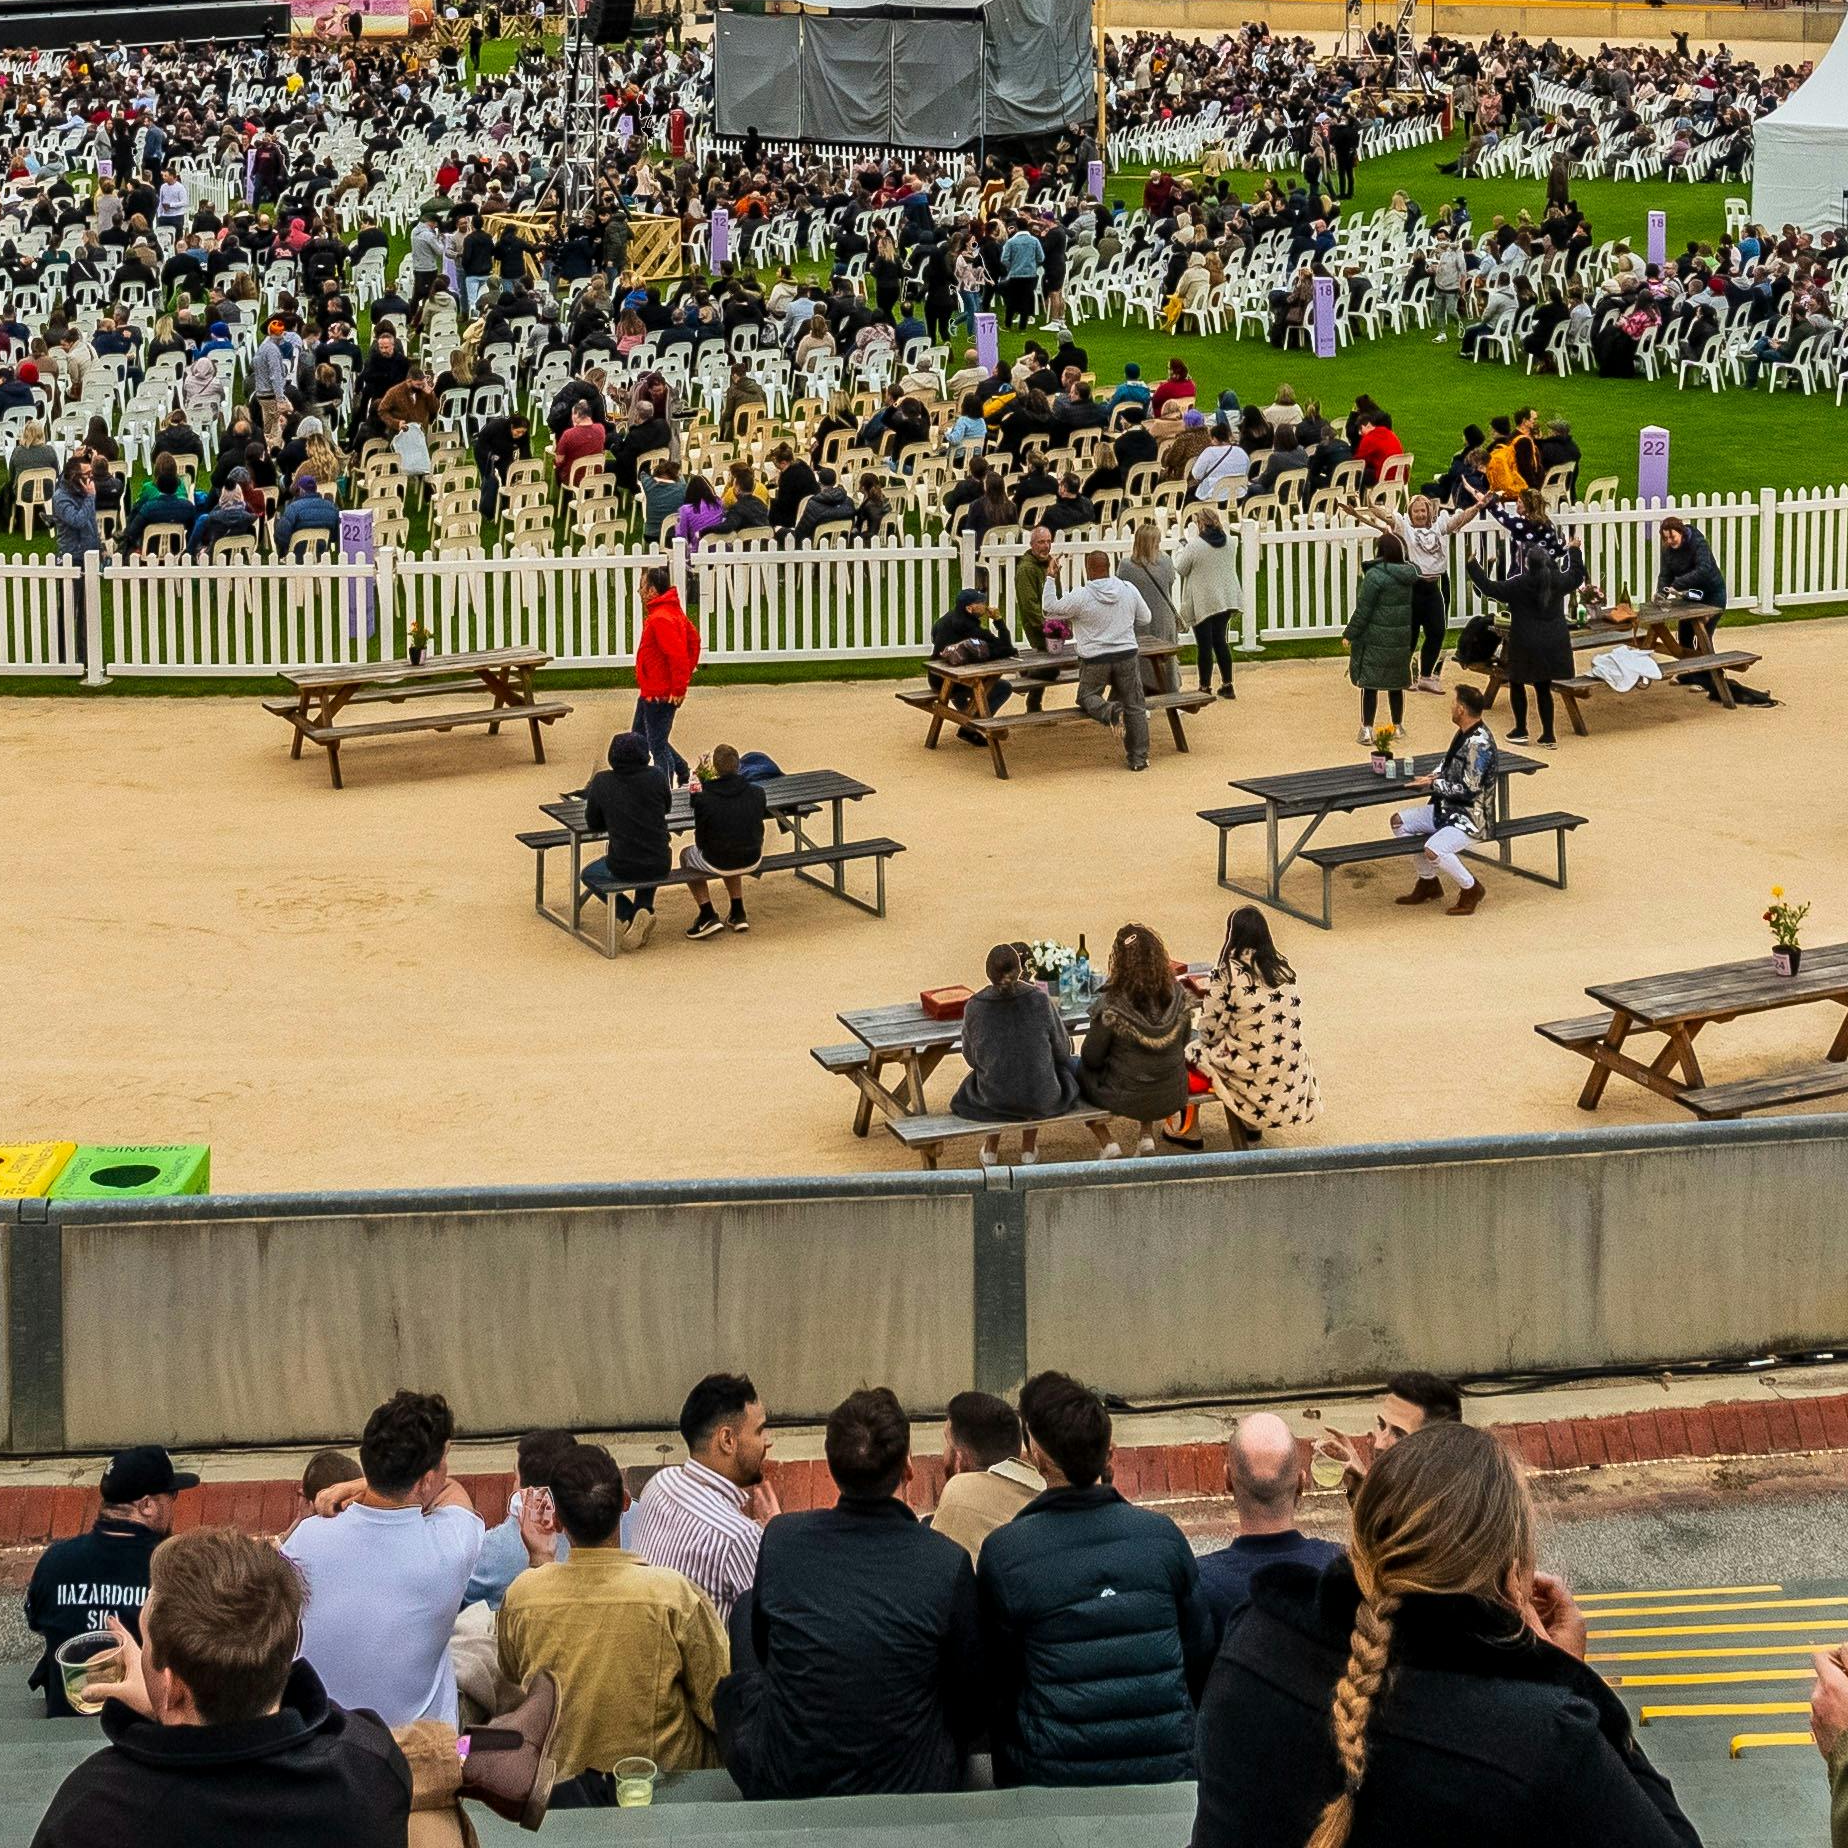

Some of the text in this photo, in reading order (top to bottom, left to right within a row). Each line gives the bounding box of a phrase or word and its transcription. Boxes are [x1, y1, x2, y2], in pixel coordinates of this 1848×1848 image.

[714, 217, 726, 227] 12
[1651, 218, 1664, 229] 18
[1318, 285, 1332, 297] 18
[981, 321, 994, 335] 17
[1642, 440, 1665, 456] 22
[343, 524, 361, 542] 22
[1372, 760, 1383, 770] 14
[1774, 958, 1786, 969] 24
[57, 1583, 147, 1607] HAZARDOU
